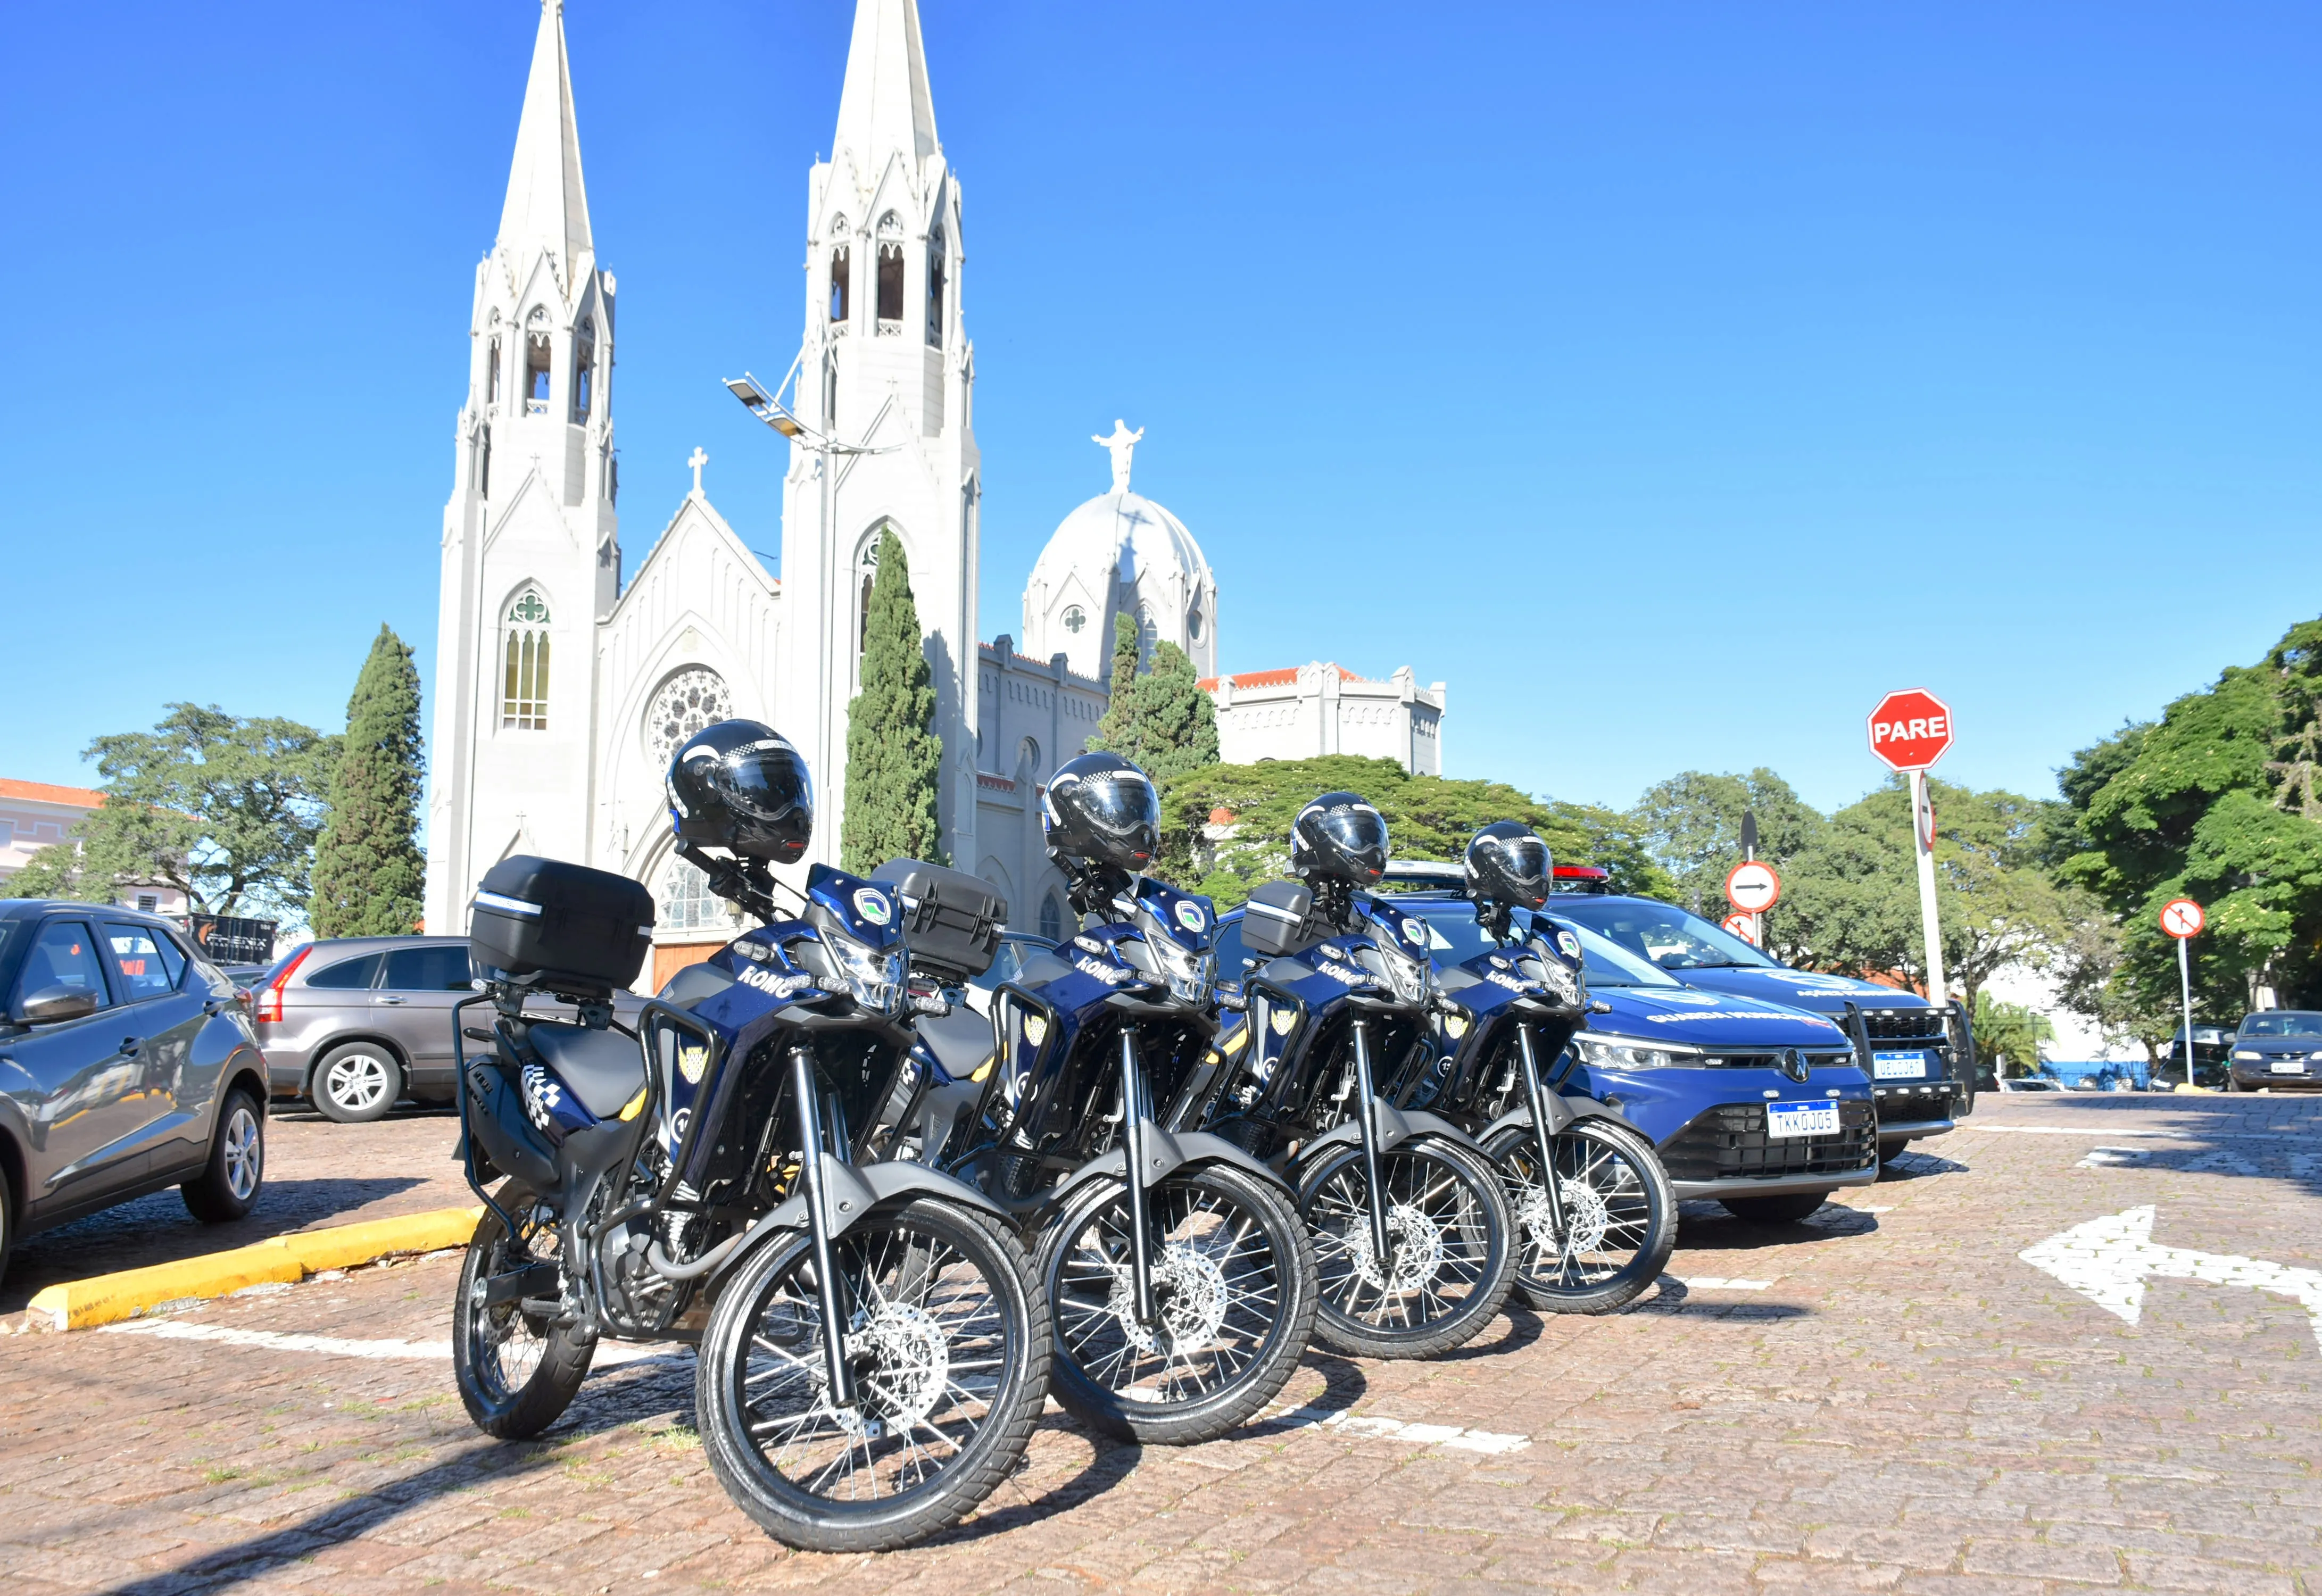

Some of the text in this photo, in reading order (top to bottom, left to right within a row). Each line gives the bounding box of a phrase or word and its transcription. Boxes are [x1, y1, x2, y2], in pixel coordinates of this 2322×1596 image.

[1875, 716, 1946, 743] PARE
[737, 965, 794, 998] ROMO
[1485, 970, 1524, 993] ROMO
[1646, 1011, 1732, 1023] GUARDA
[1777, 1112, 1832, 1133] TKK0J05
